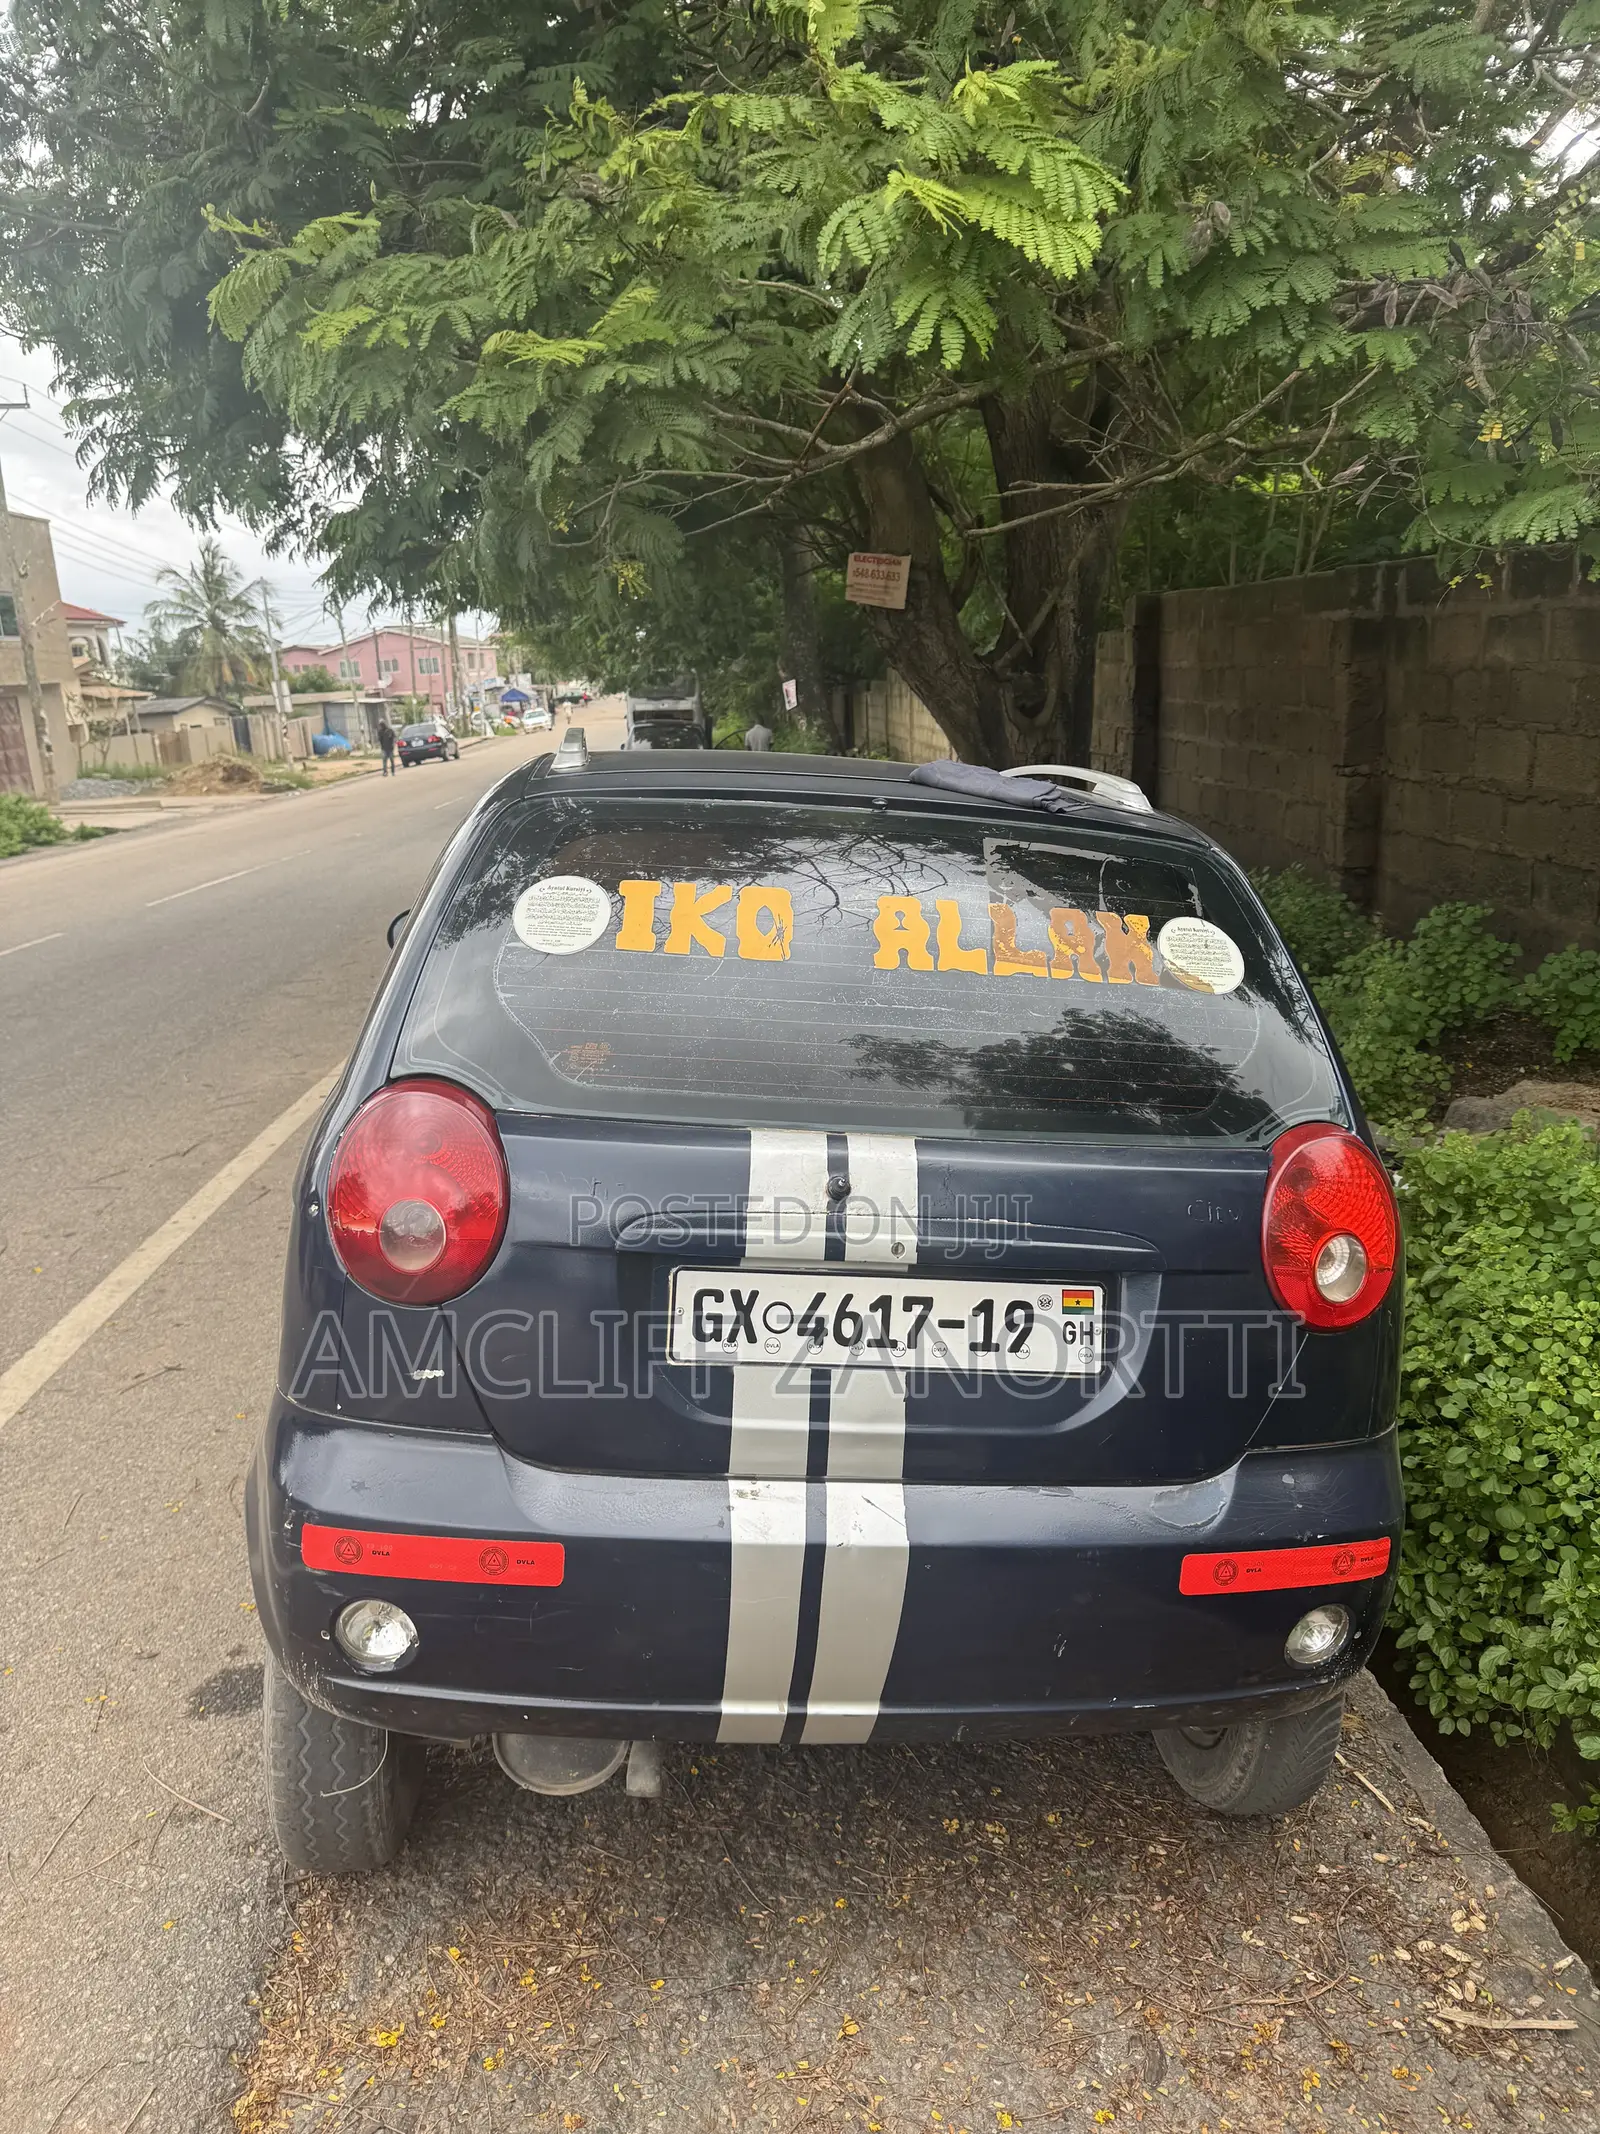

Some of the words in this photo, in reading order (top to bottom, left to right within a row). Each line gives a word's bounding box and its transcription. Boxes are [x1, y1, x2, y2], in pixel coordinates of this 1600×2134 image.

[615, 879, 794, 962] IKO
[691, 1288, 760, 1345] GX
[796, 1291, 1036, 1354] 4617-19
[1062, 1320, 1094, 1346] GH
